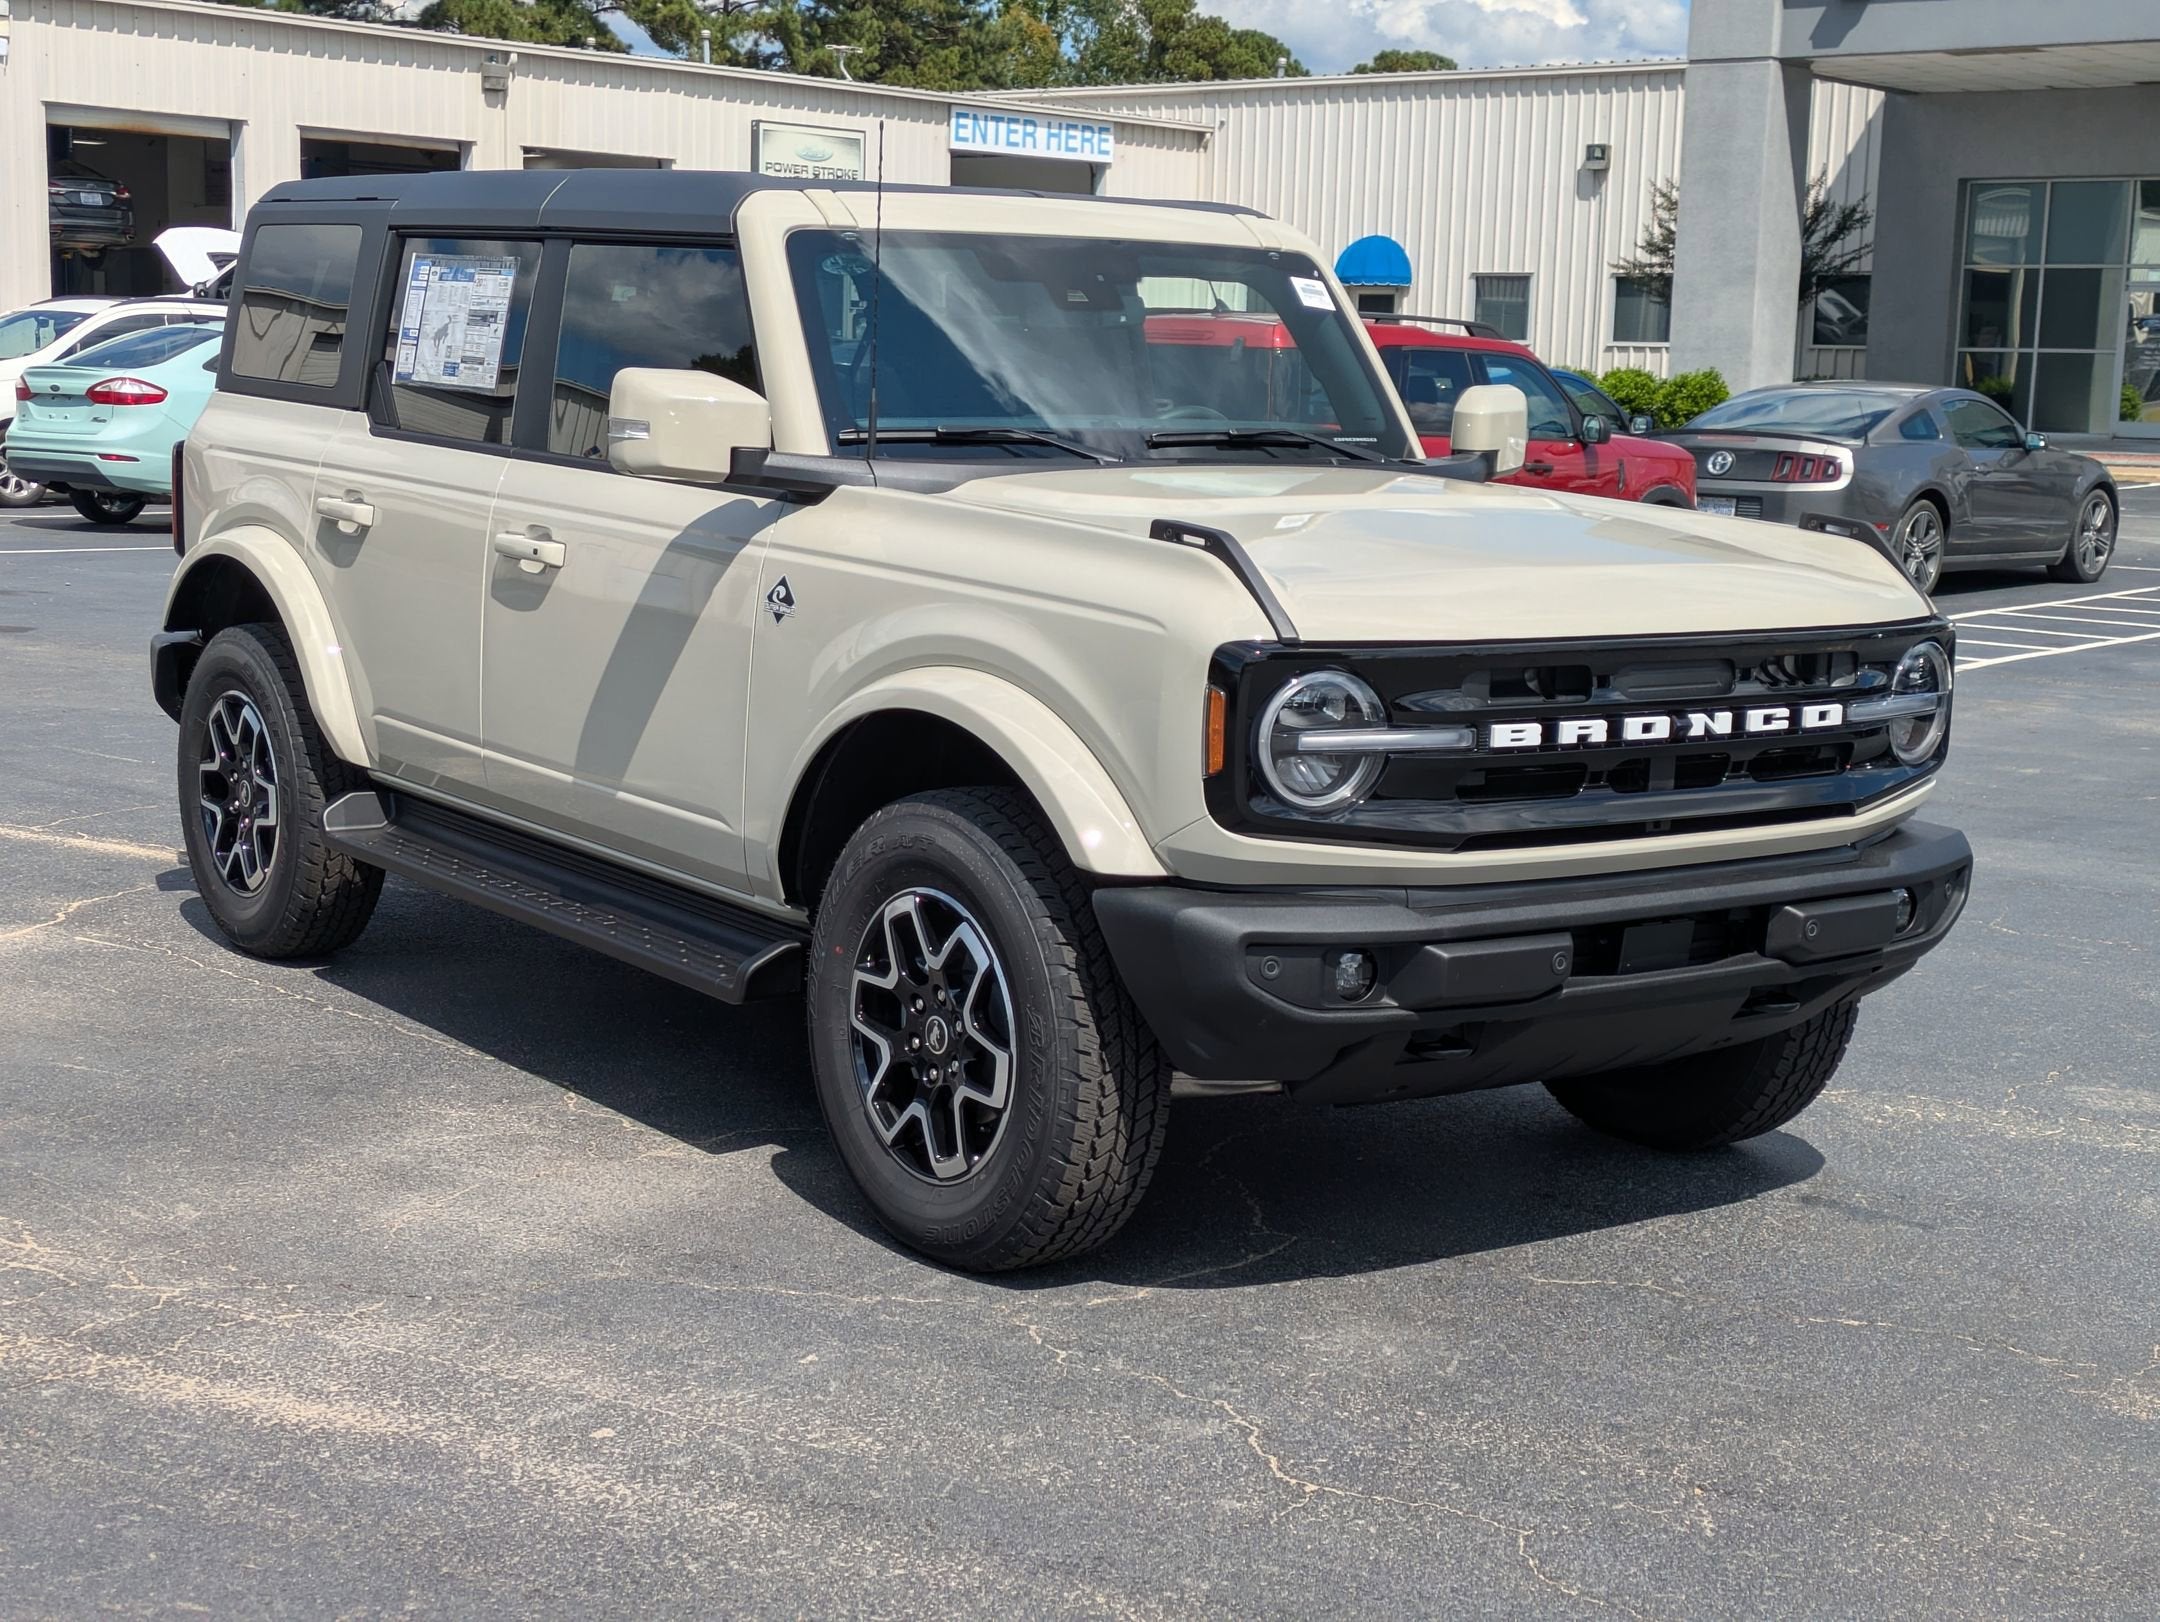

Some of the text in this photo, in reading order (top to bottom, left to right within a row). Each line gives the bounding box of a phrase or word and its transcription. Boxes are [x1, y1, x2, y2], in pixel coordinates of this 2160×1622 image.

[954, 112, 1111, 156] ENTER HERE
[765, 162, 809, 175] POWER
[812, 166, 859, 180] STROKE
[1489, 703, 1844, 749] BRONCO
[922, 1006, 1047, 1245] BRIDGESTONE
